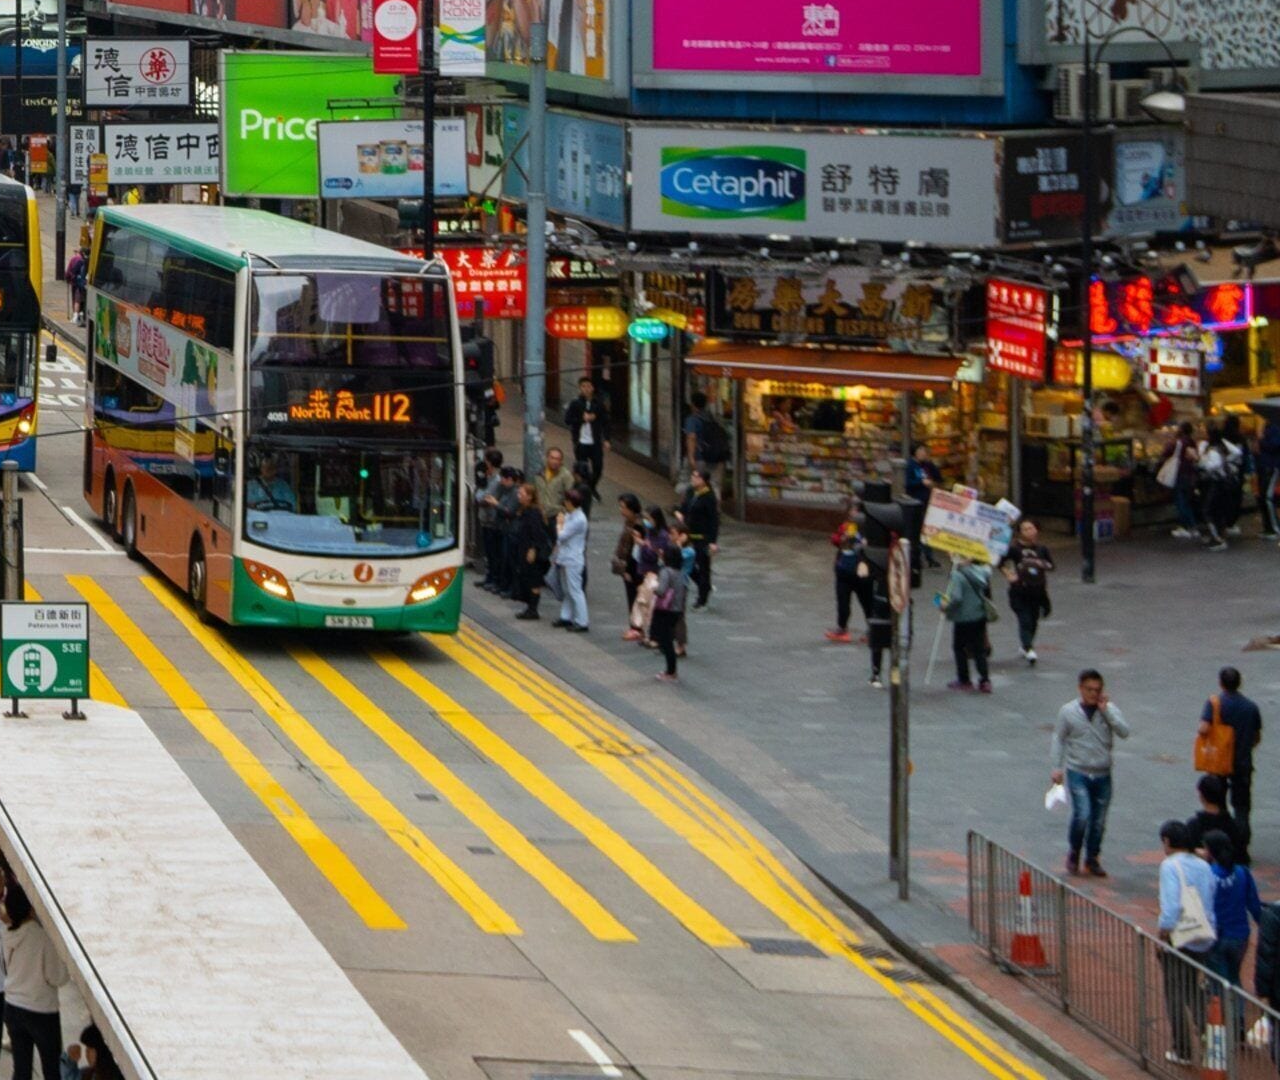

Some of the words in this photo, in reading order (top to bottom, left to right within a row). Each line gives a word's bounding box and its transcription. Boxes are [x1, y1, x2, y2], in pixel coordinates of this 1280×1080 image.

[442, 7, 482, 18] KONG
[673, 167, 795, 204] Cetaphil
[821, 163, 951, 199] 舒特膚
[290, 405, 331, 420] North
[335, 404, 371, 420] Point
[373, 393, 411, 422] 112
[34, 609, 82, 621] 百德新街
